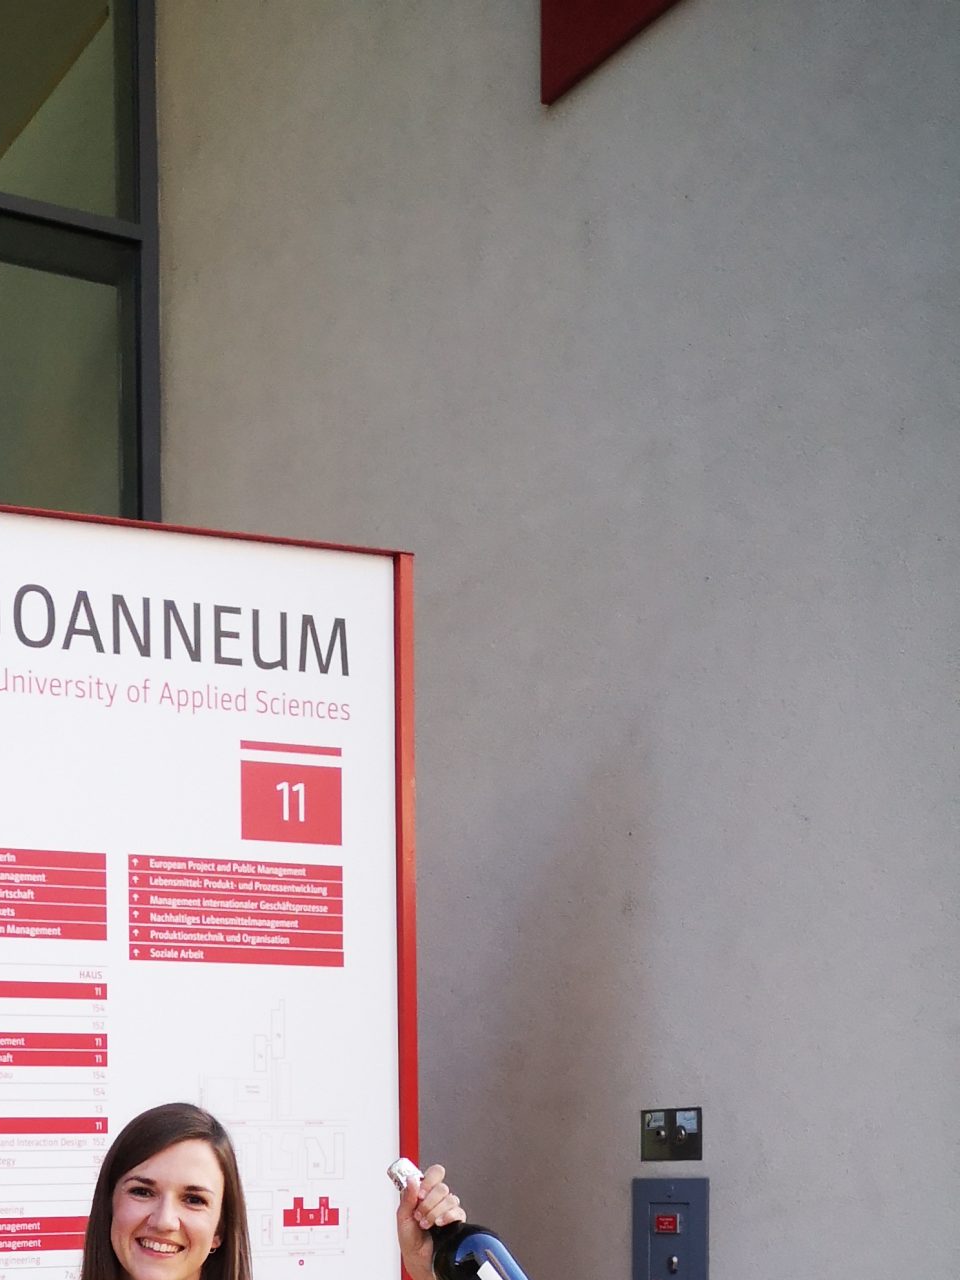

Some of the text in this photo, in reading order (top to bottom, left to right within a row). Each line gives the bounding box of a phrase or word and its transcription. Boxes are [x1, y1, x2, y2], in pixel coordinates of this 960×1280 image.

[127, 679, 150, 703] of
[159, 681, 246, 715] Applied
[257, 691, 350, 721] Sciences
[276, 782, 305, 822] 11
[150, 859, 306, 877] European Project and Public Management
[204, 880, 237, 889] Produkt-
[239, 881, 253, 890] und
[255, 882, 327, 896] Prozessentwicklung
[150, 896, 200, 907] Management
[260, 901, 328, 913] Geschäftsprozesse
[150, 913, 299, 929] Nachhaltiges Lebensmittelmanagement
[7, 924, 61, 937] Management
[150, 930, 290, 944] Produktionstechnik und Organisation
[150, 949, 204, 959] Soziale Arbeit
[80, 971, 102, 979] HAUS
[95, 987, 101, 996] 11
[95, 1038, 102, 1046] 11
[95, 1055, 102, 1063] 11
[96, 1122, 102, 1130] 11
